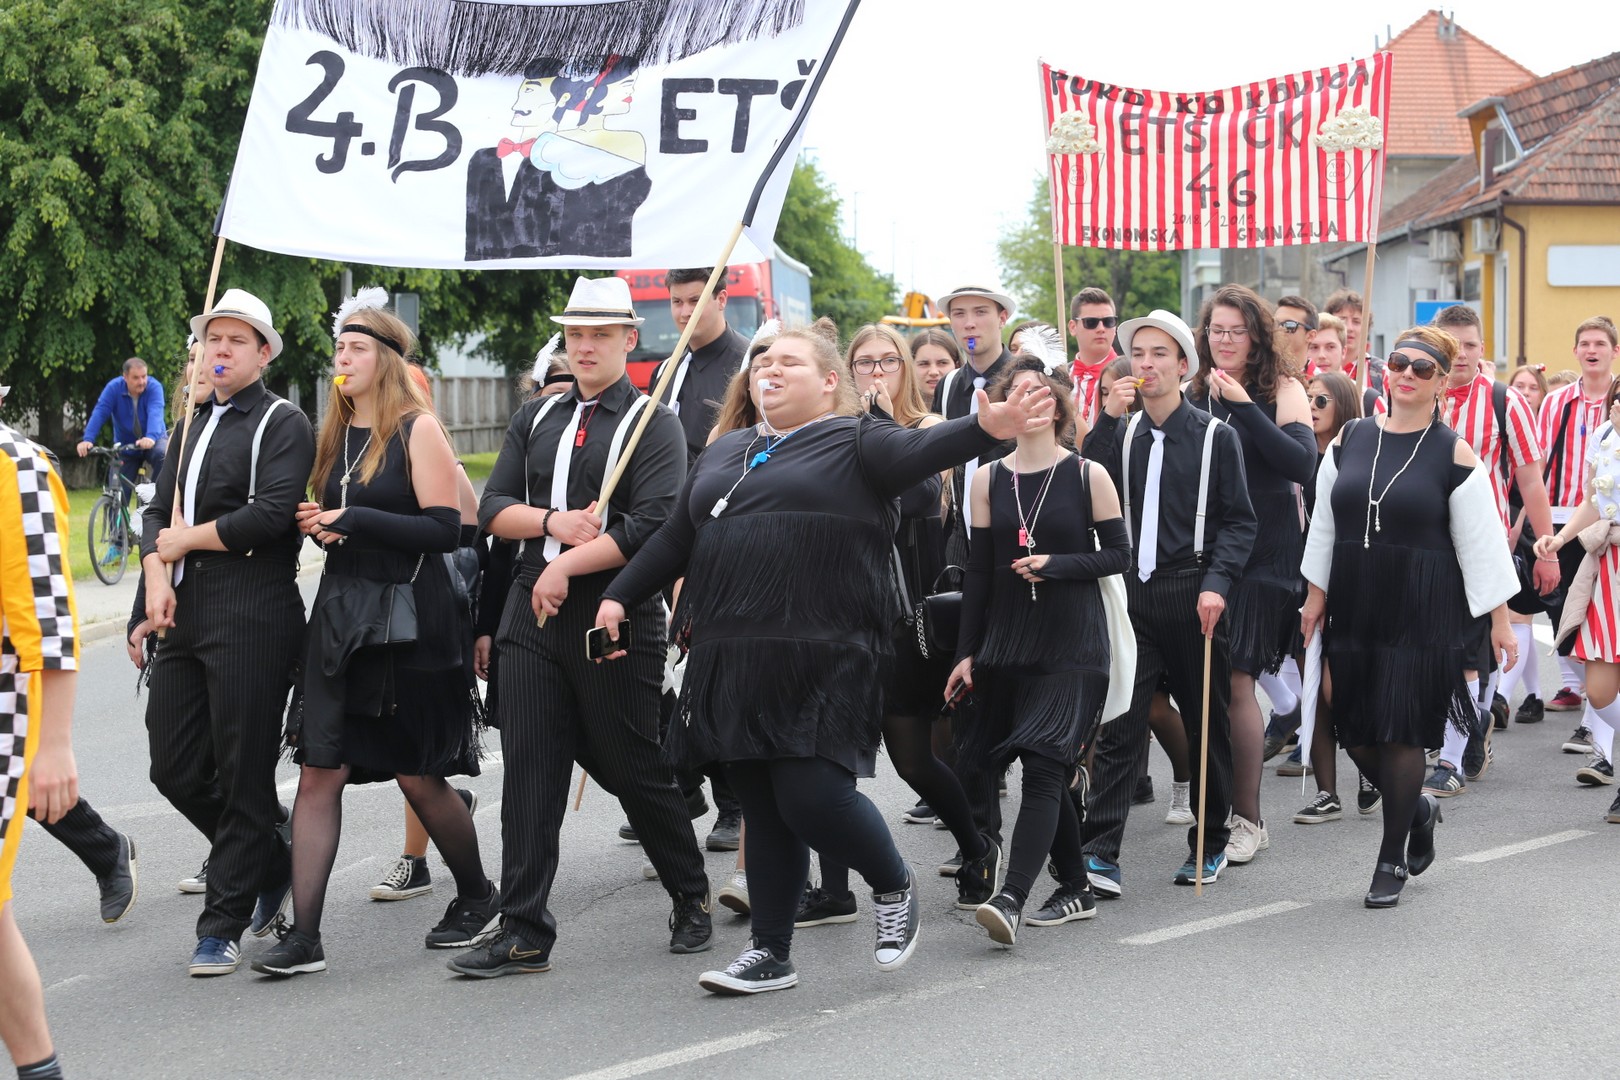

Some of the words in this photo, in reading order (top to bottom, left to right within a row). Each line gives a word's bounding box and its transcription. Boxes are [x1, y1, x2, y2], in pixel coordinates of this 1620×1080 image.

[285, 50, 462, 184] 4.B
[1118, 112, 1209, 156] ETŠ
[1242, 106, 1304, 149] ČK
[1081, 225, 1184, 243] EKONOMSKA
[1237, 220, 1339, 242] GIMNAZIJA
